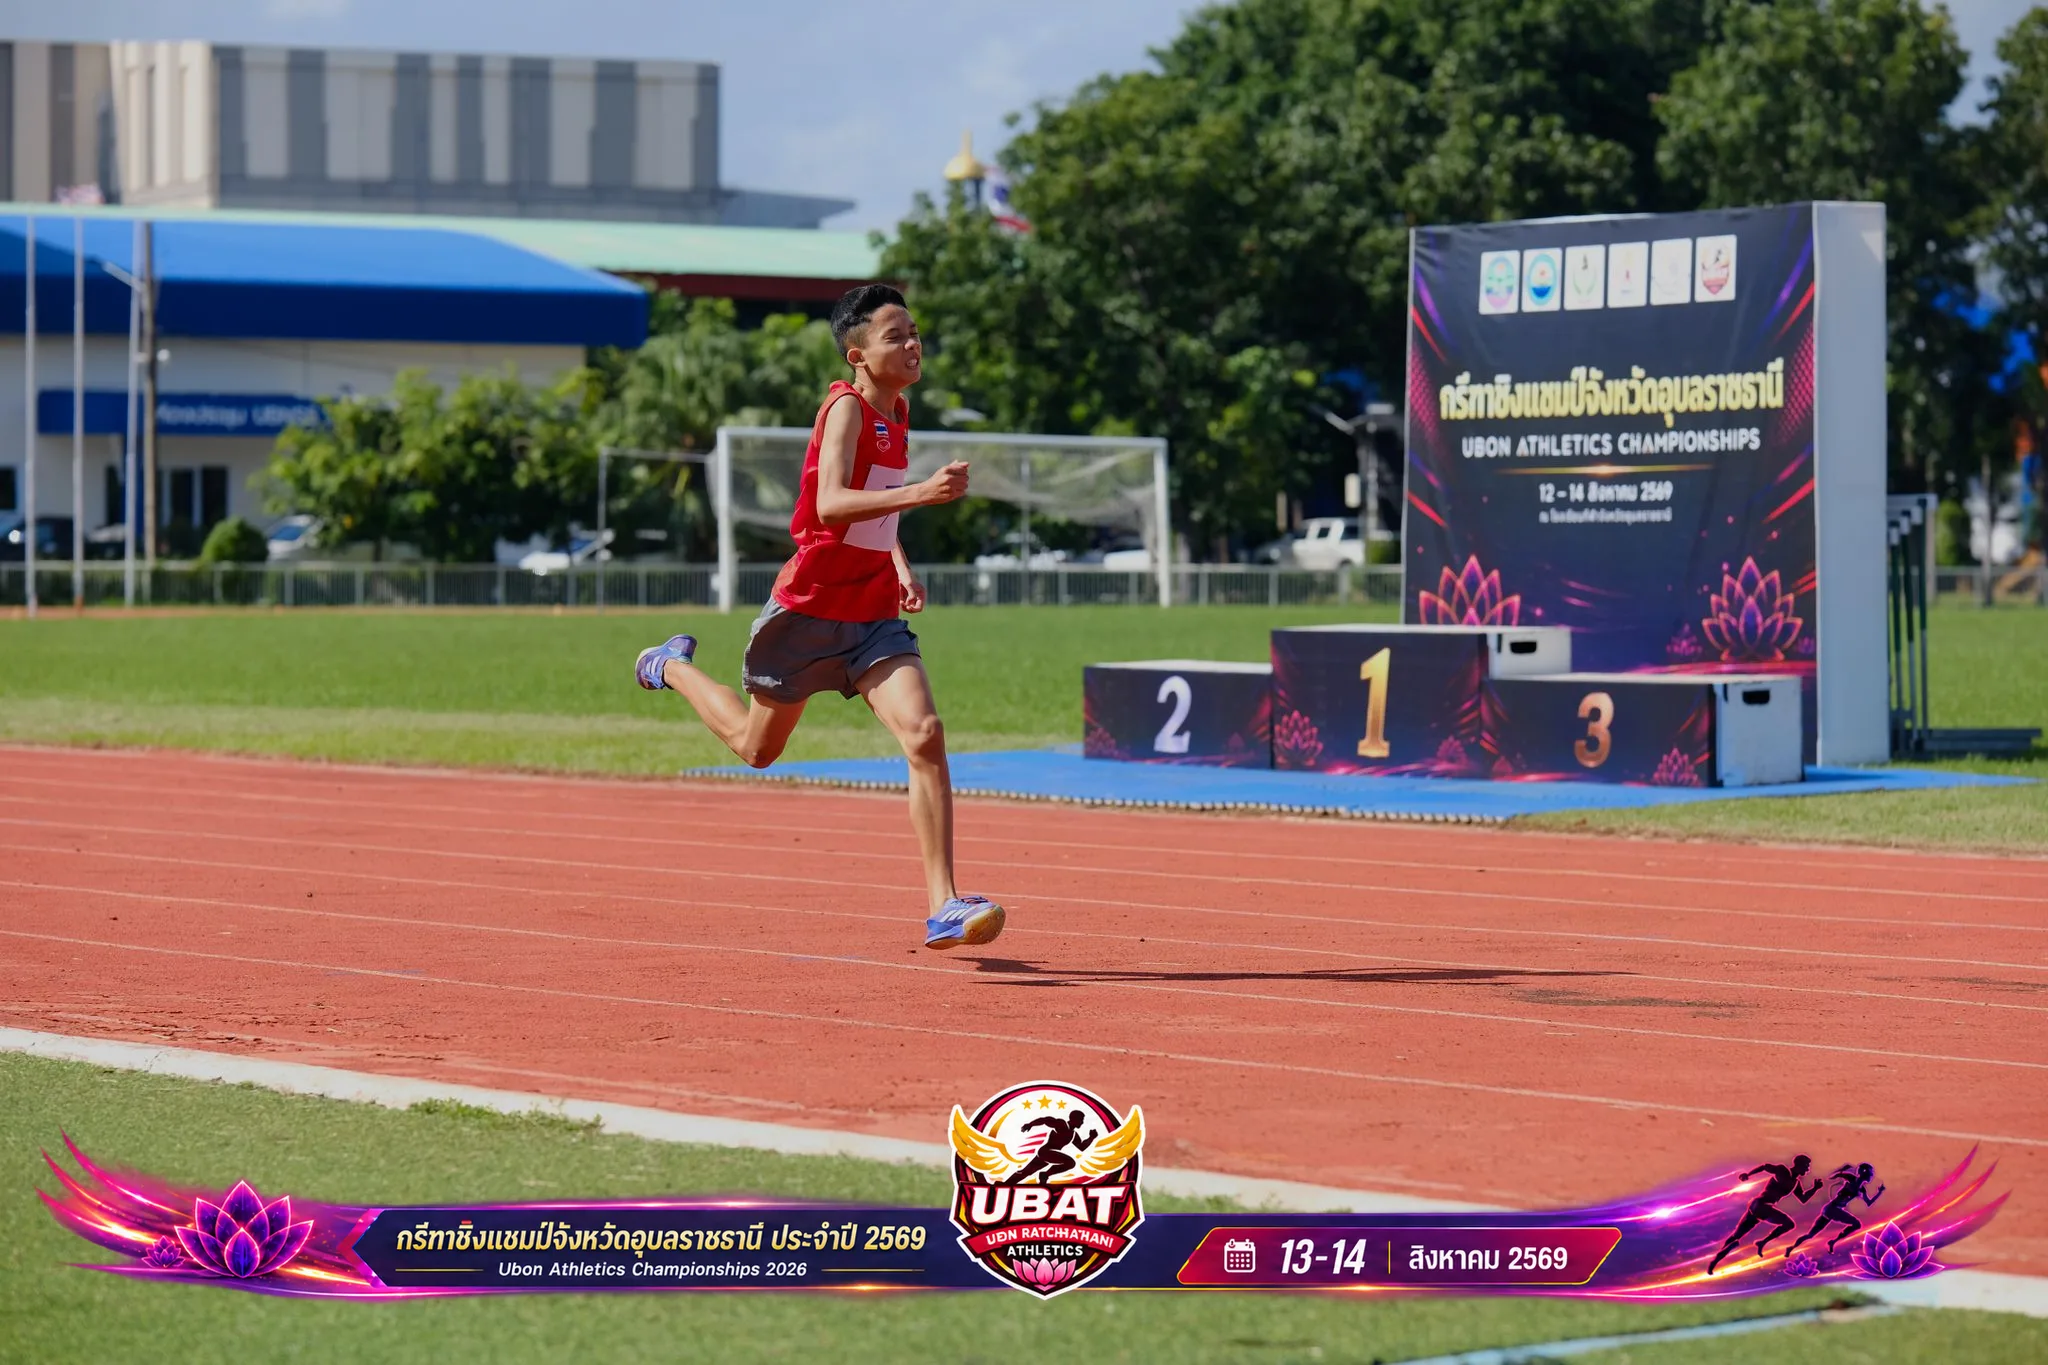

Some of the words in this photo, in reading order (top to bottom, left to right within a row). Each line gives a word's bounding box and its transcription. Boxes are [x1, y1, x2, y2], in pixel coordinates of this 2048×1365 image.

[1462, 436, 1511, 458] UBON
[1516, 434, 1612, 457] ATHLETICS
[1618, 428, 1760, 455] CHAMPIONSHIPS
[1539, 483, 1555, 502] 12
[1153, 675, 1192, 753] 2
[1357, 647, 1391, 758] 1
[1574, 692, 1615, 768] 3
